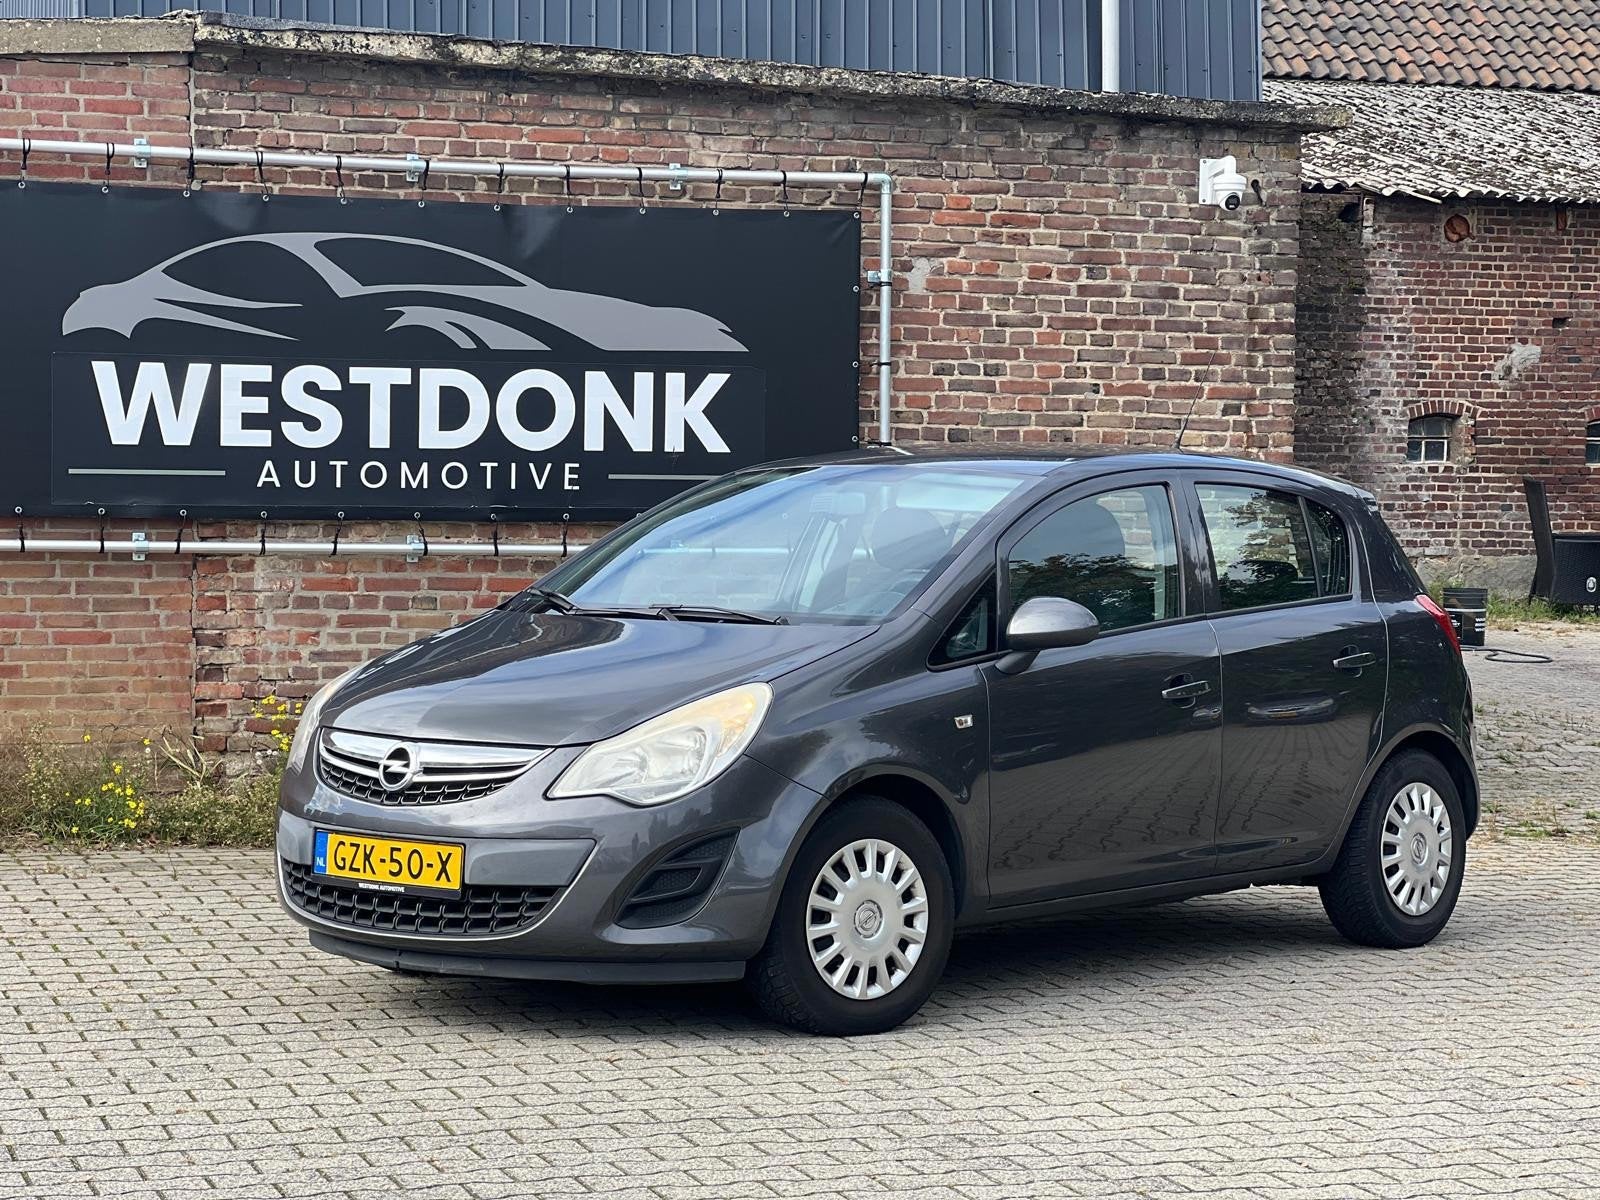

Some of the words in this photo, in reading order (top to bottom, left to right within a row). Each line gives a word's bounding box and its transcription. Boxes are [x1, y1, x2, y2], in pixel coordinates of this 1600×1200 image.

[91, 361, 731, 453] WESTDONK
[256, 460, 581, 491] AUTOMOTIVE
[316, 857, 326, 867] NL
[333, 840, 453, 883] GZK-50-X
